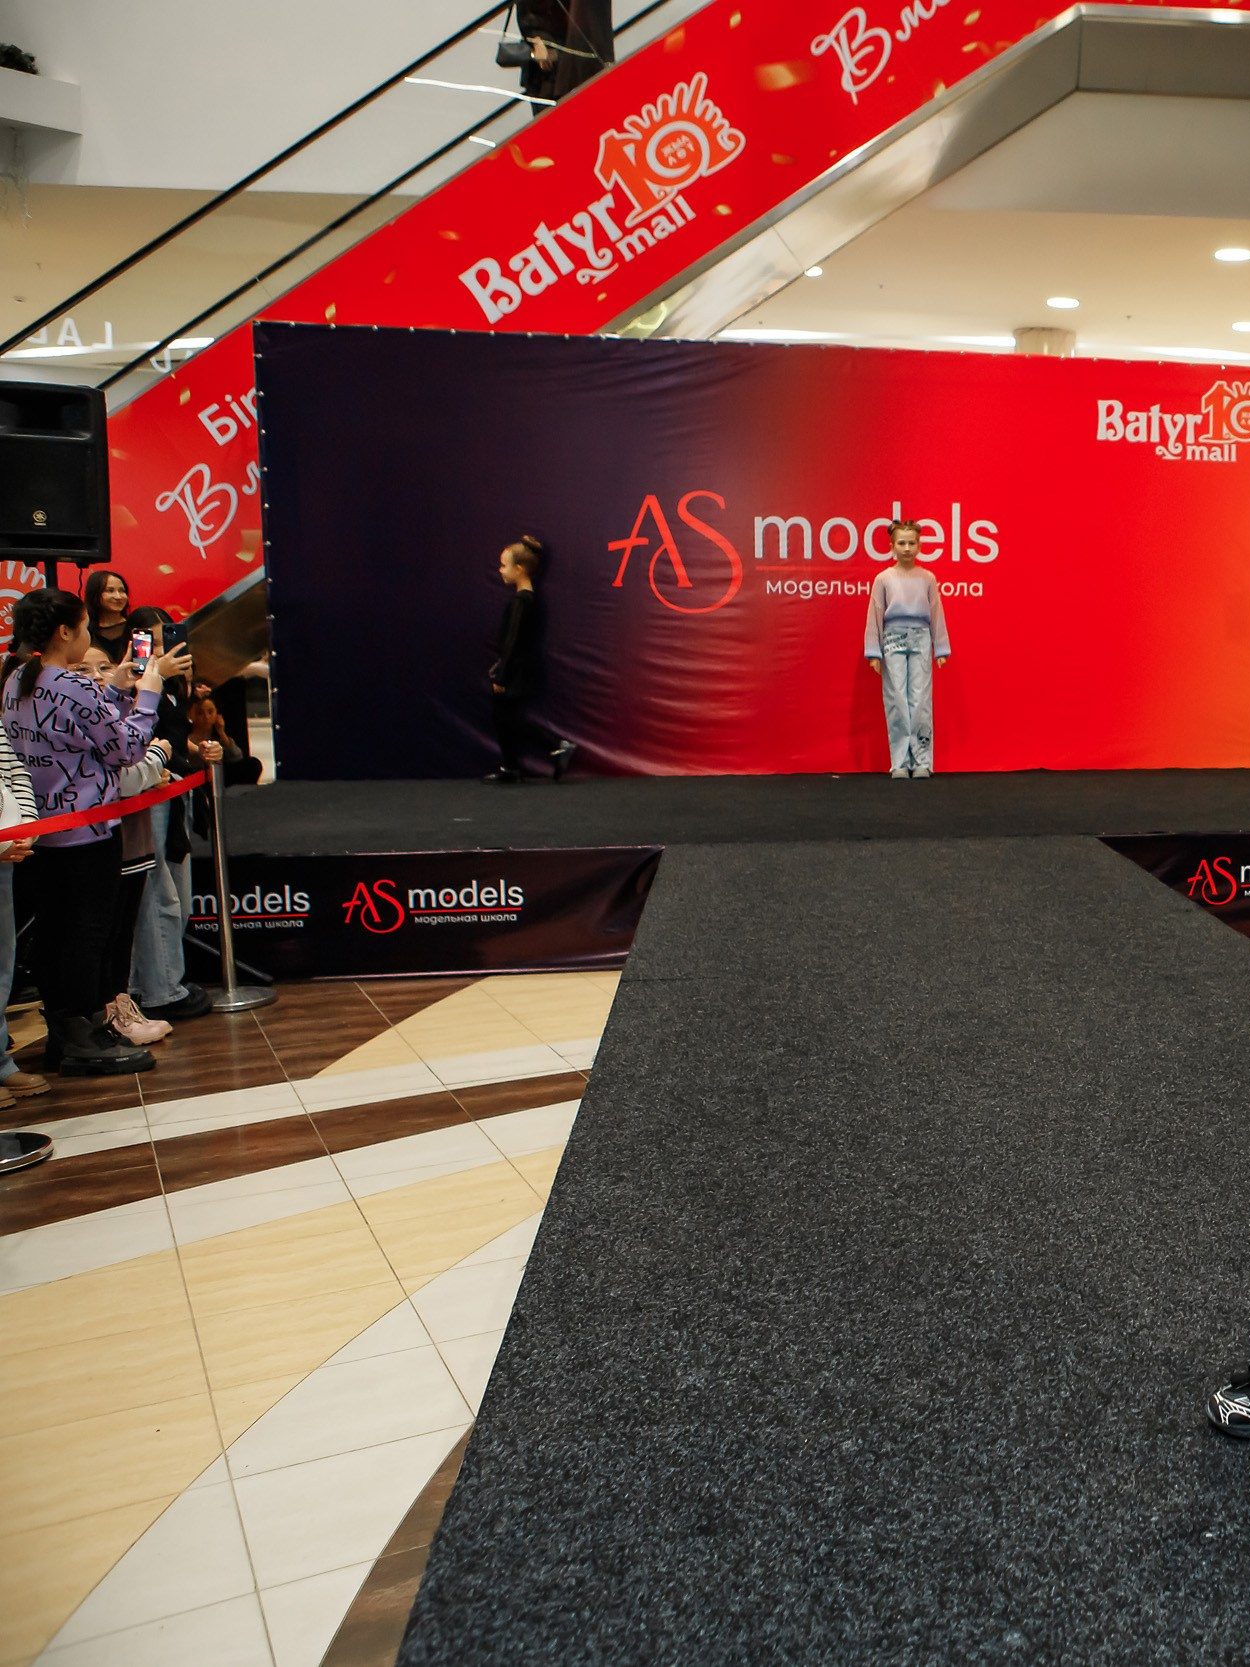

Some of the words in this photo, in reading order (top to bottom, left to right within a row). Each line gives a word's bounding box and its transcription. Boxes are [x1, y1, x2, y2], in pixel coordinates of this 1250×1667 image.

[616, 194, 697, 262] mall
[458, 193, 623, 324] Batyr
[1096, 399, 1204, 460] Batyr
[1186, 444, 1237, 462] mall
[608, 490, 743, 614] AS
[753, 501, 1000, 563] models
[766, 578, 870, 600] модельн
[341, 879, 405, 934] AS
[408, 879, 524, 909] models
[1187, 856, 1238, 906] AS
[194, 921, 263, 932] модьная
[414, 914, 478, 925] модельная
[480, 913, 518, 923] школа
